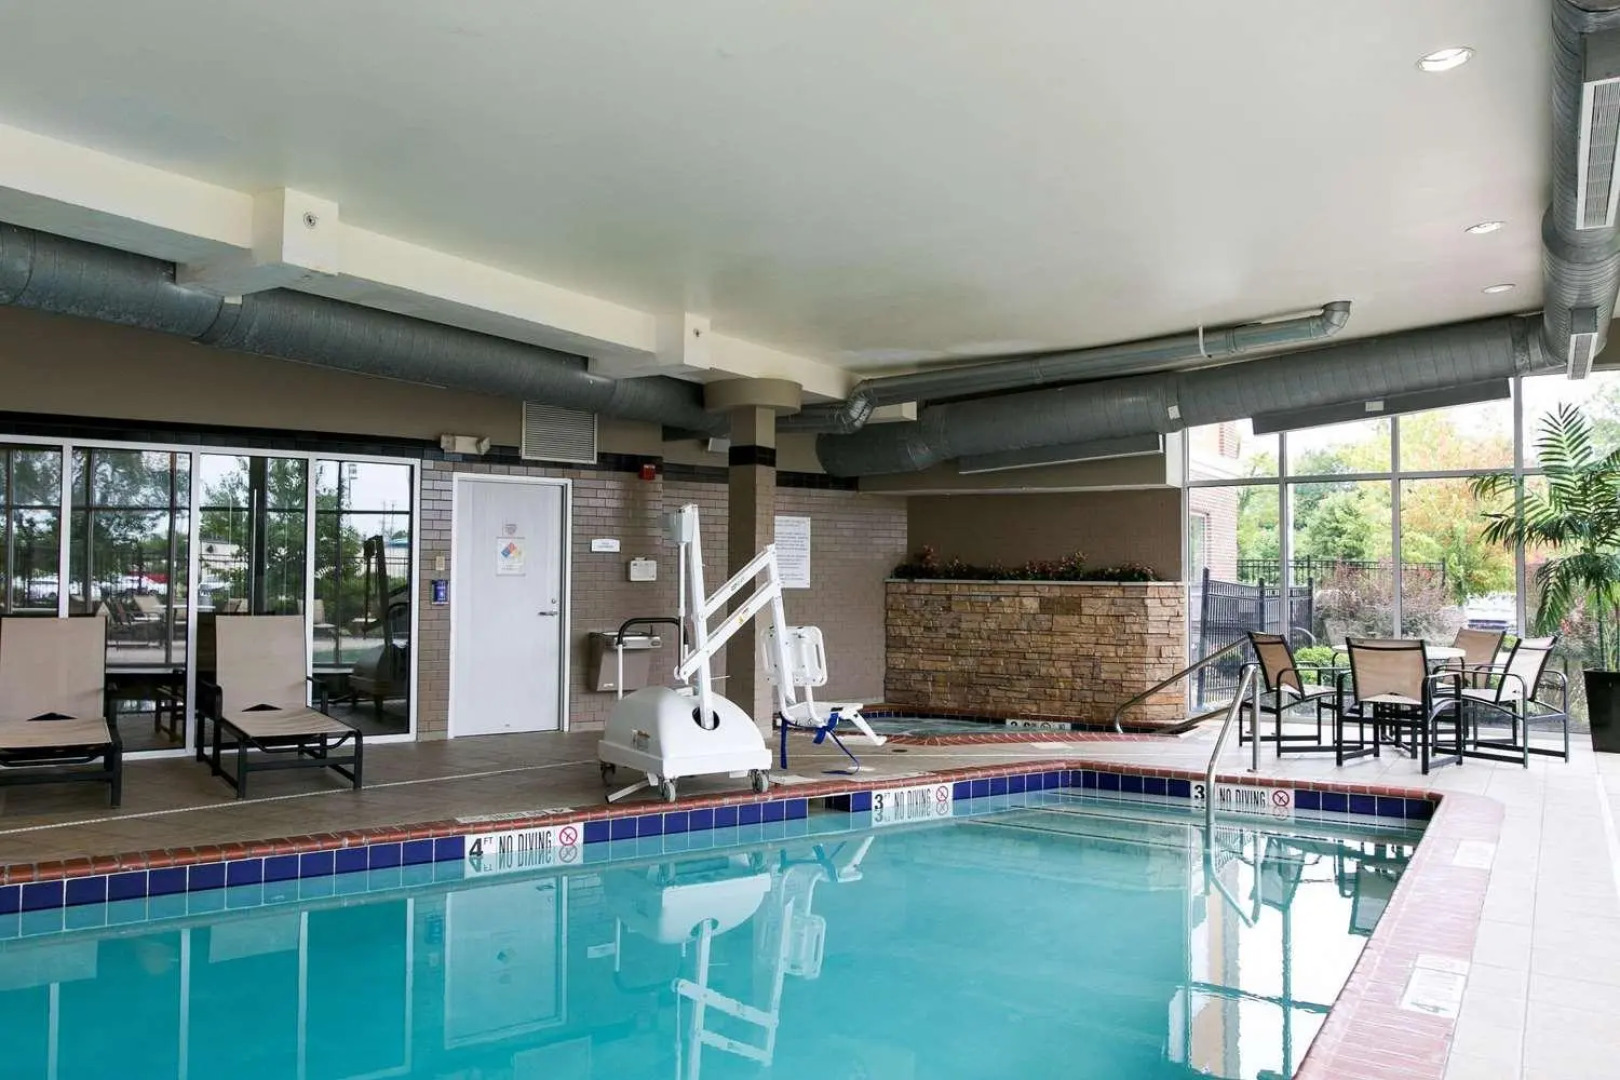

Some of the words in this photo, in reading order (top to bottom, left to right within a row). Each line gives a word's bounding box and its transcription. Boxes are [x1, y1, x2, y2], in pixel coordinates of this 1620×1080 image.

[874, 793, 884, 809] 3
[894, 791, 905, 807] NO
[907, 788, 931, 806] DIVING
[1194, 784, 1205, 800] 3
[1219, 787, 1232, 802] NO
[1235, 788, 1266, 807] DIVING
[469, 837, 483, 856] 4
[484, 836, 493, 845] FT
[499, 834, 513, 853] NO
[519, 830, 552, 852] DIVING
